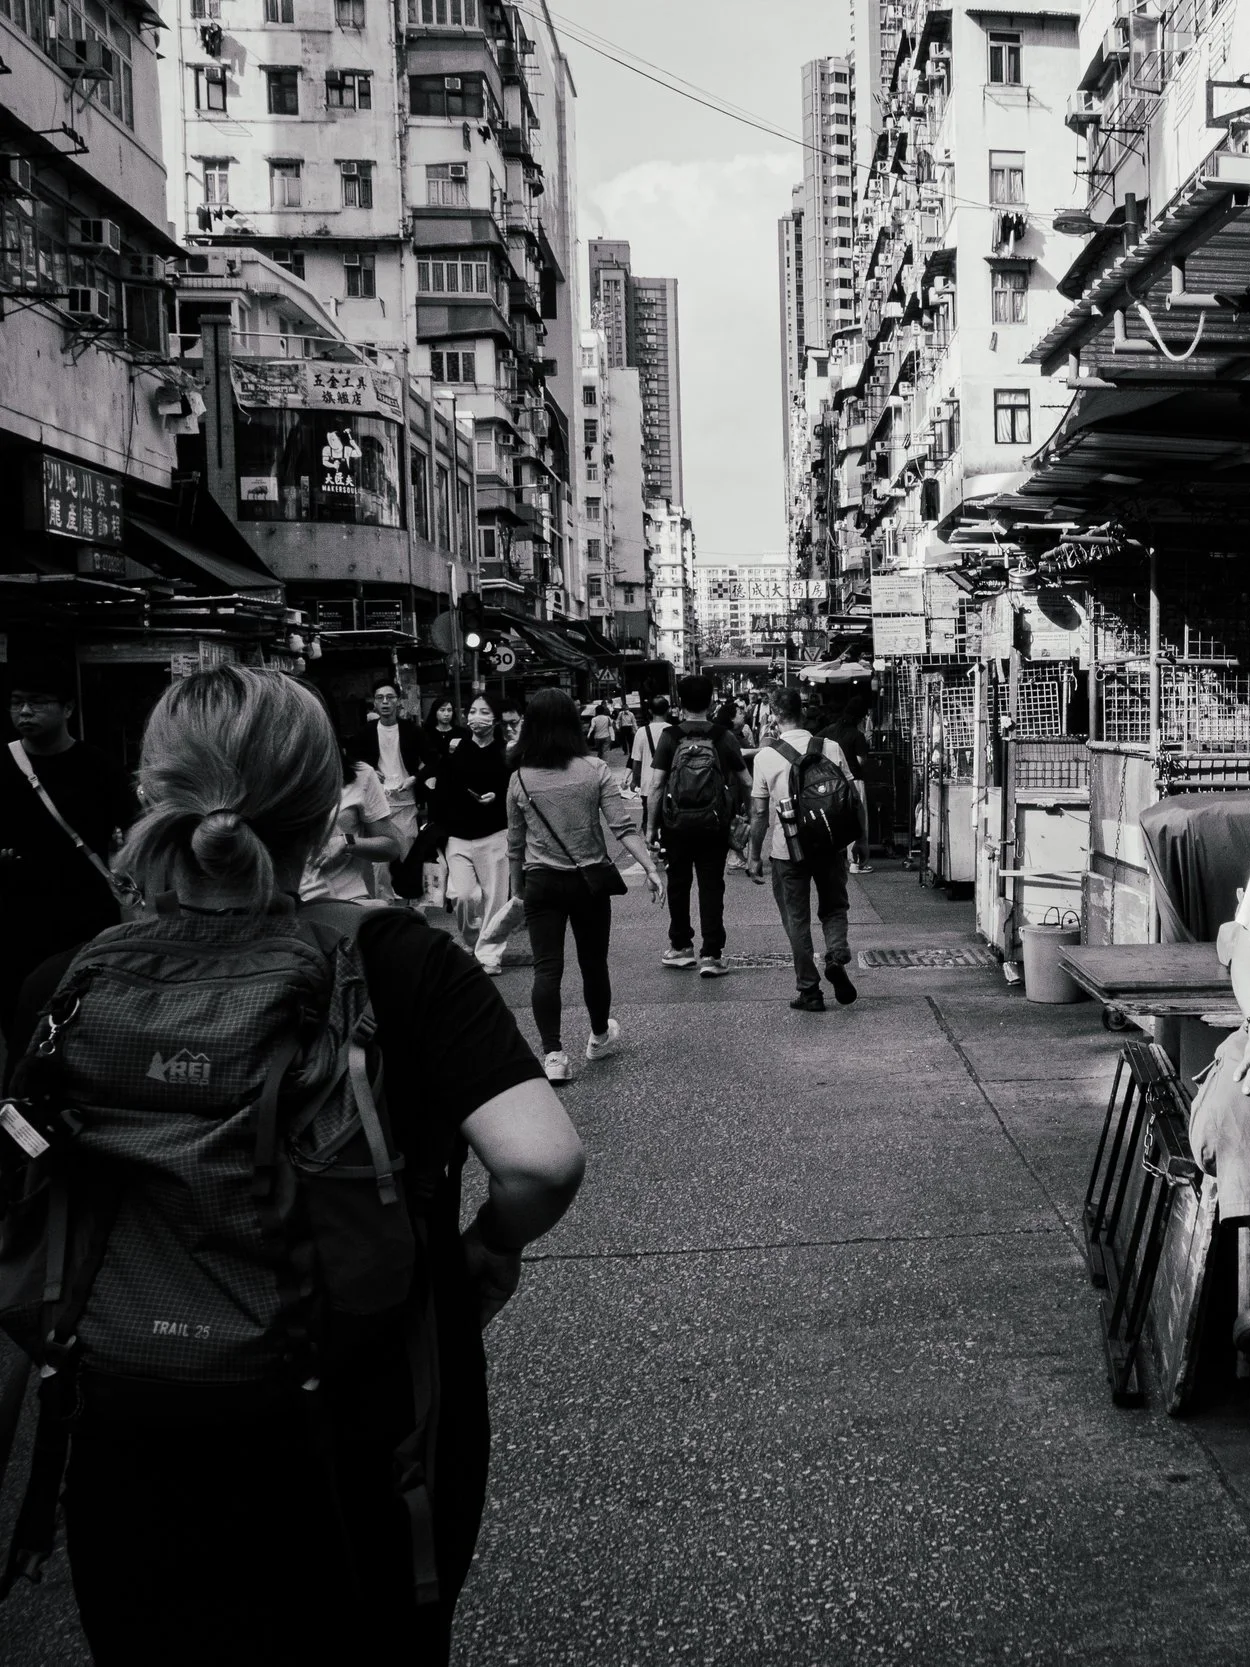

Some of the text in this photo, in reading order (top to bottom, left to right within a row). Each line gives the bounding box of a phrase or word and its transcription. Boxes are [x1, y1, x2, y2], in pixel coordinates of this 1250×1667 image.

[313, 374, 367, 390] 五金工具
[321, 485, 358, 495] MAKERSOUL
[494, 653, 513, 666] 30
[170, 1061, 211, 1077] REI
[153, 1320, 211, 1340] TRAIL 25
